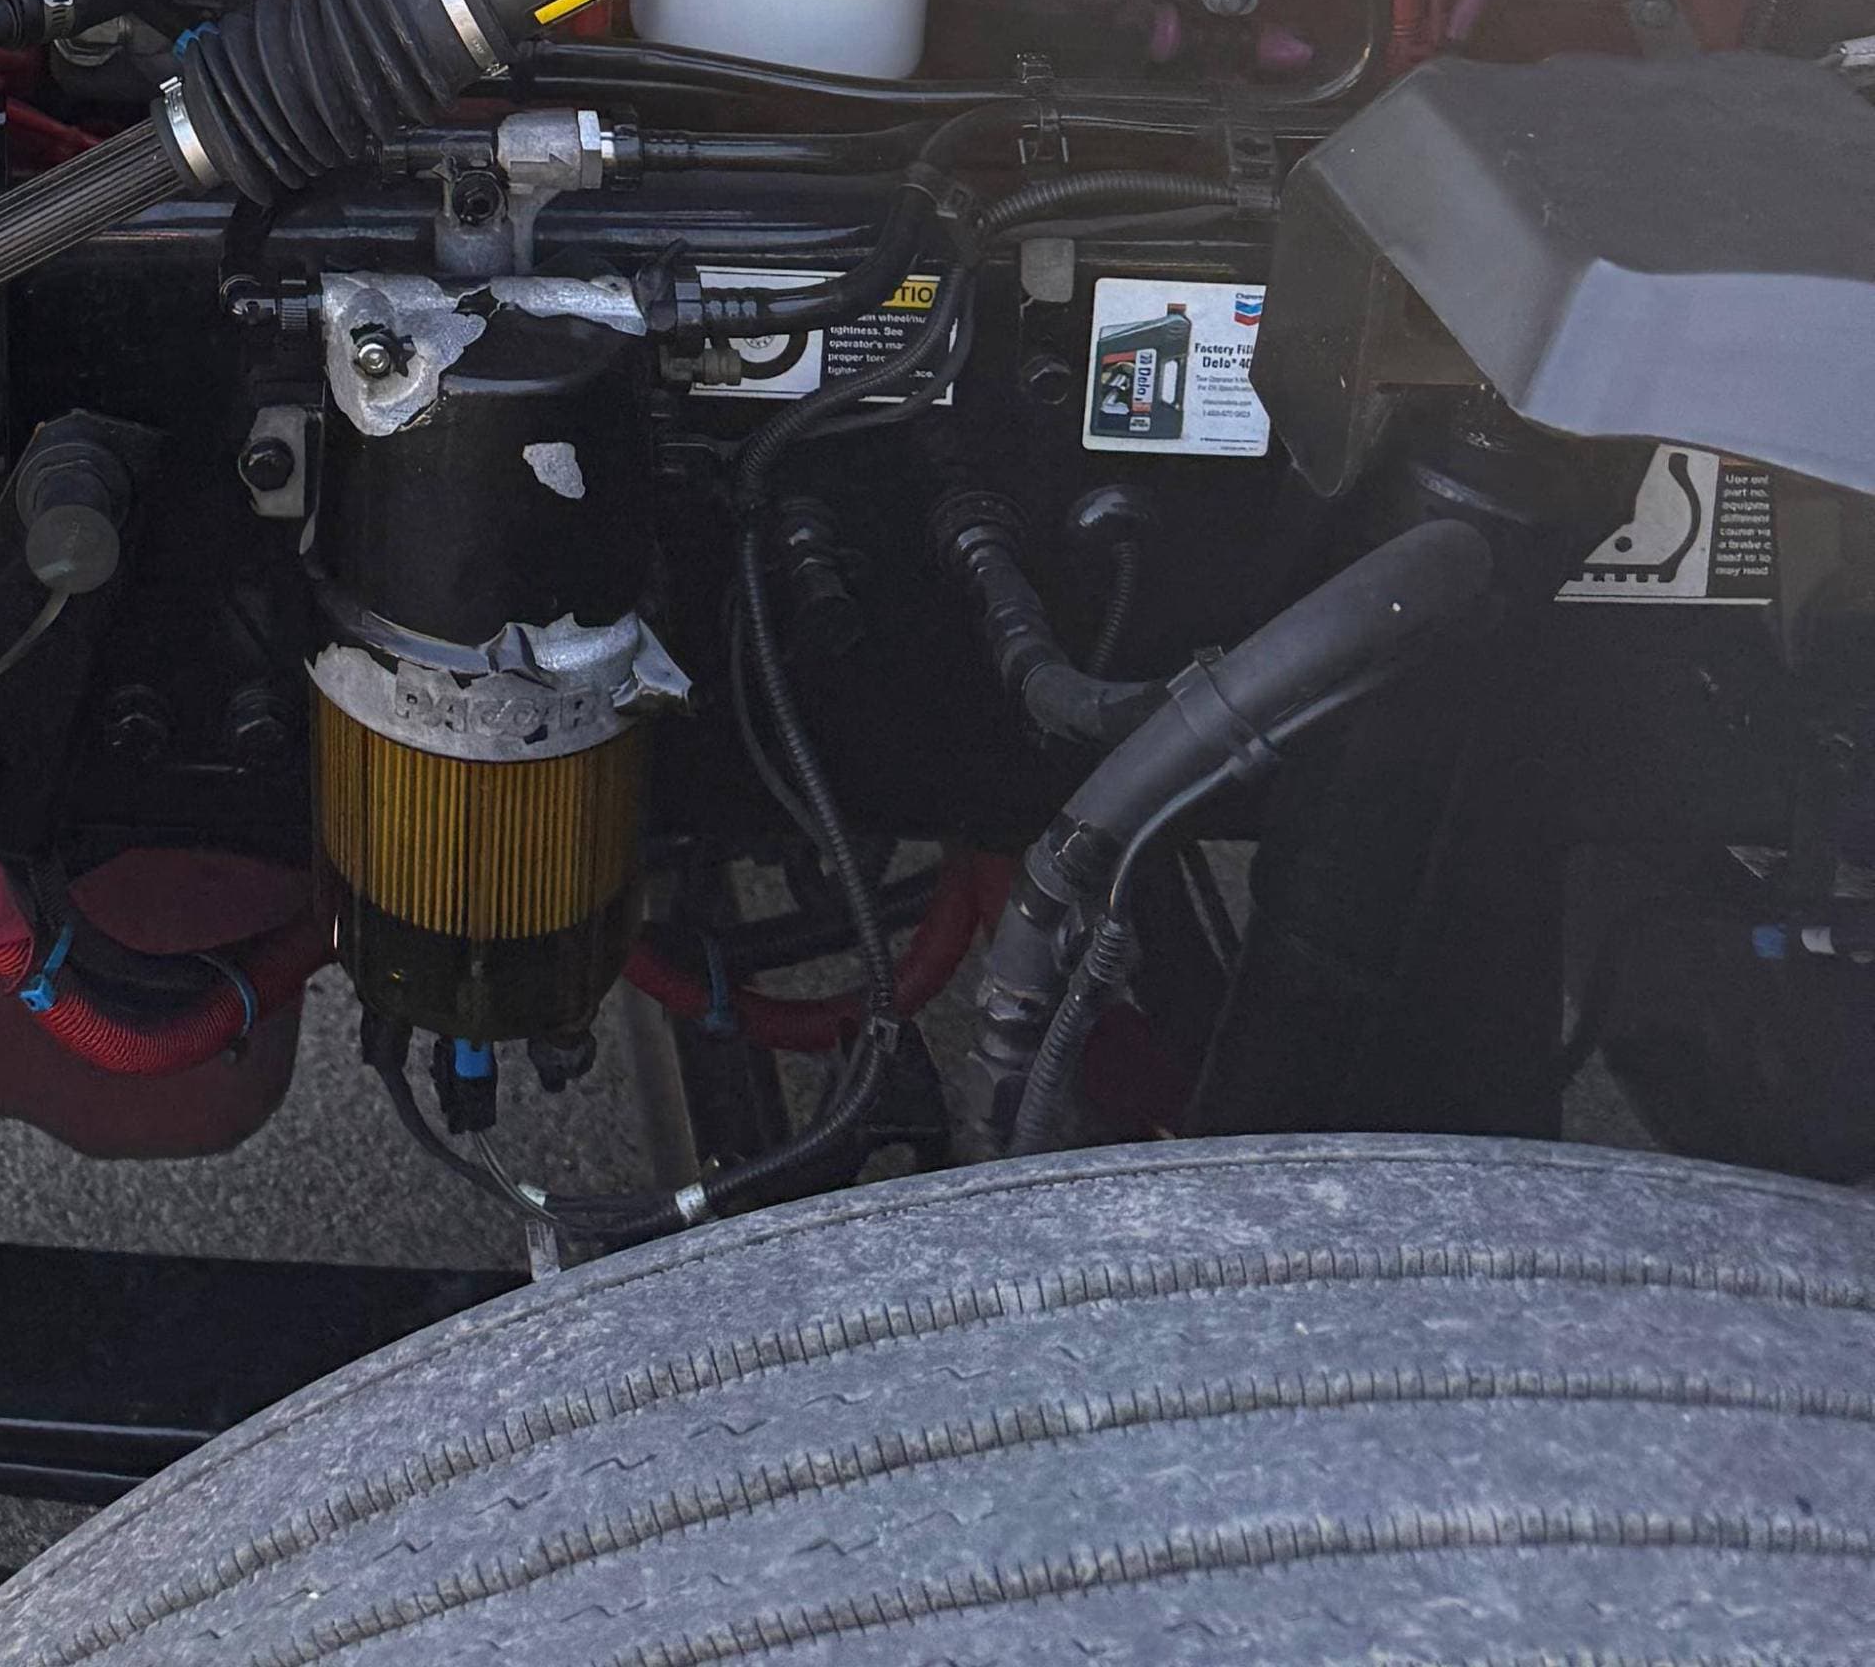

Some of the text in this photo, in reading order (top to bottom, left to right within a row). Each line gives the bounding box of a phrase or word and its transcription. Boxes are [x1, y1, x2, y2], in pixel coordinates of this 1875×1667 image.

[884, 327, 903, 336] See
[829, 340, 883, 349] operator's
[1195, 343, 1234, 356] Factory
[828, 353, 863, 363] proper
[1726, 474, 1748, 484] Use
